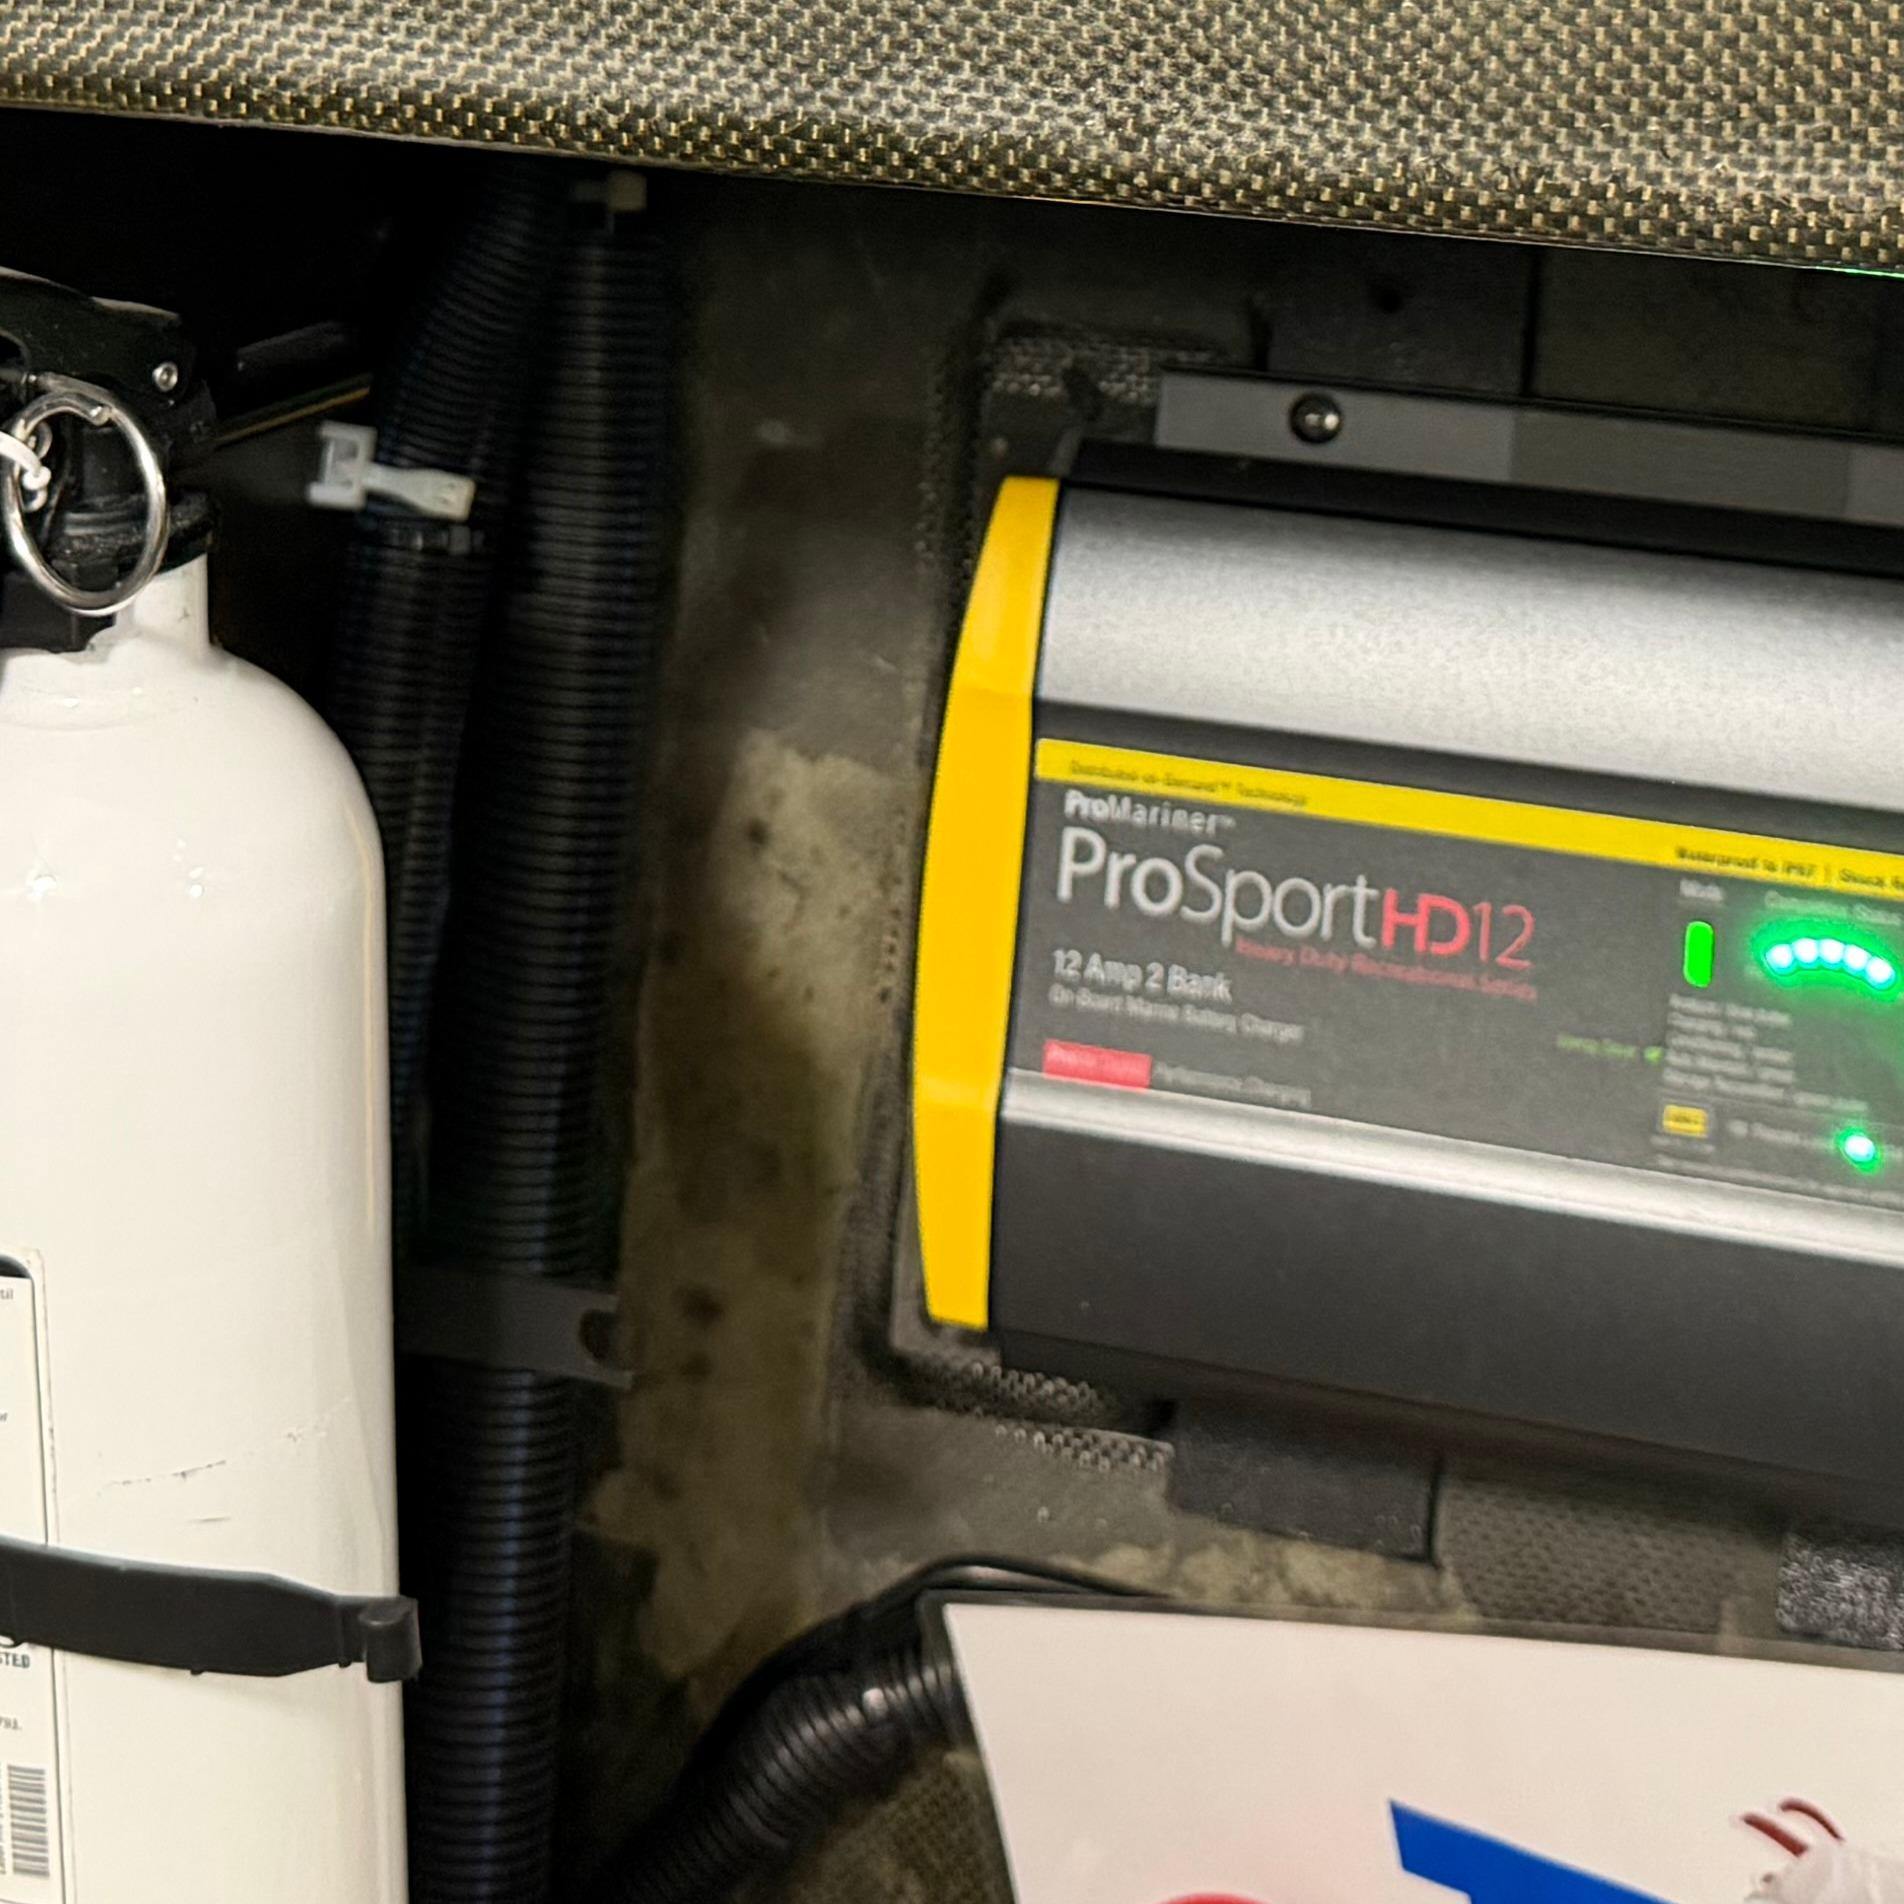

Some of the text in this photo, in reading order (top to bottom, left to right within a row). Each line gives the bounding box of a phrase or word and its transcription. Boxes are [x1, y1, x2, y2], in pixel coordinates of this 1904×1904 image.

[1053, 948, 1233, 1003] 12 Amp 2 Bank
